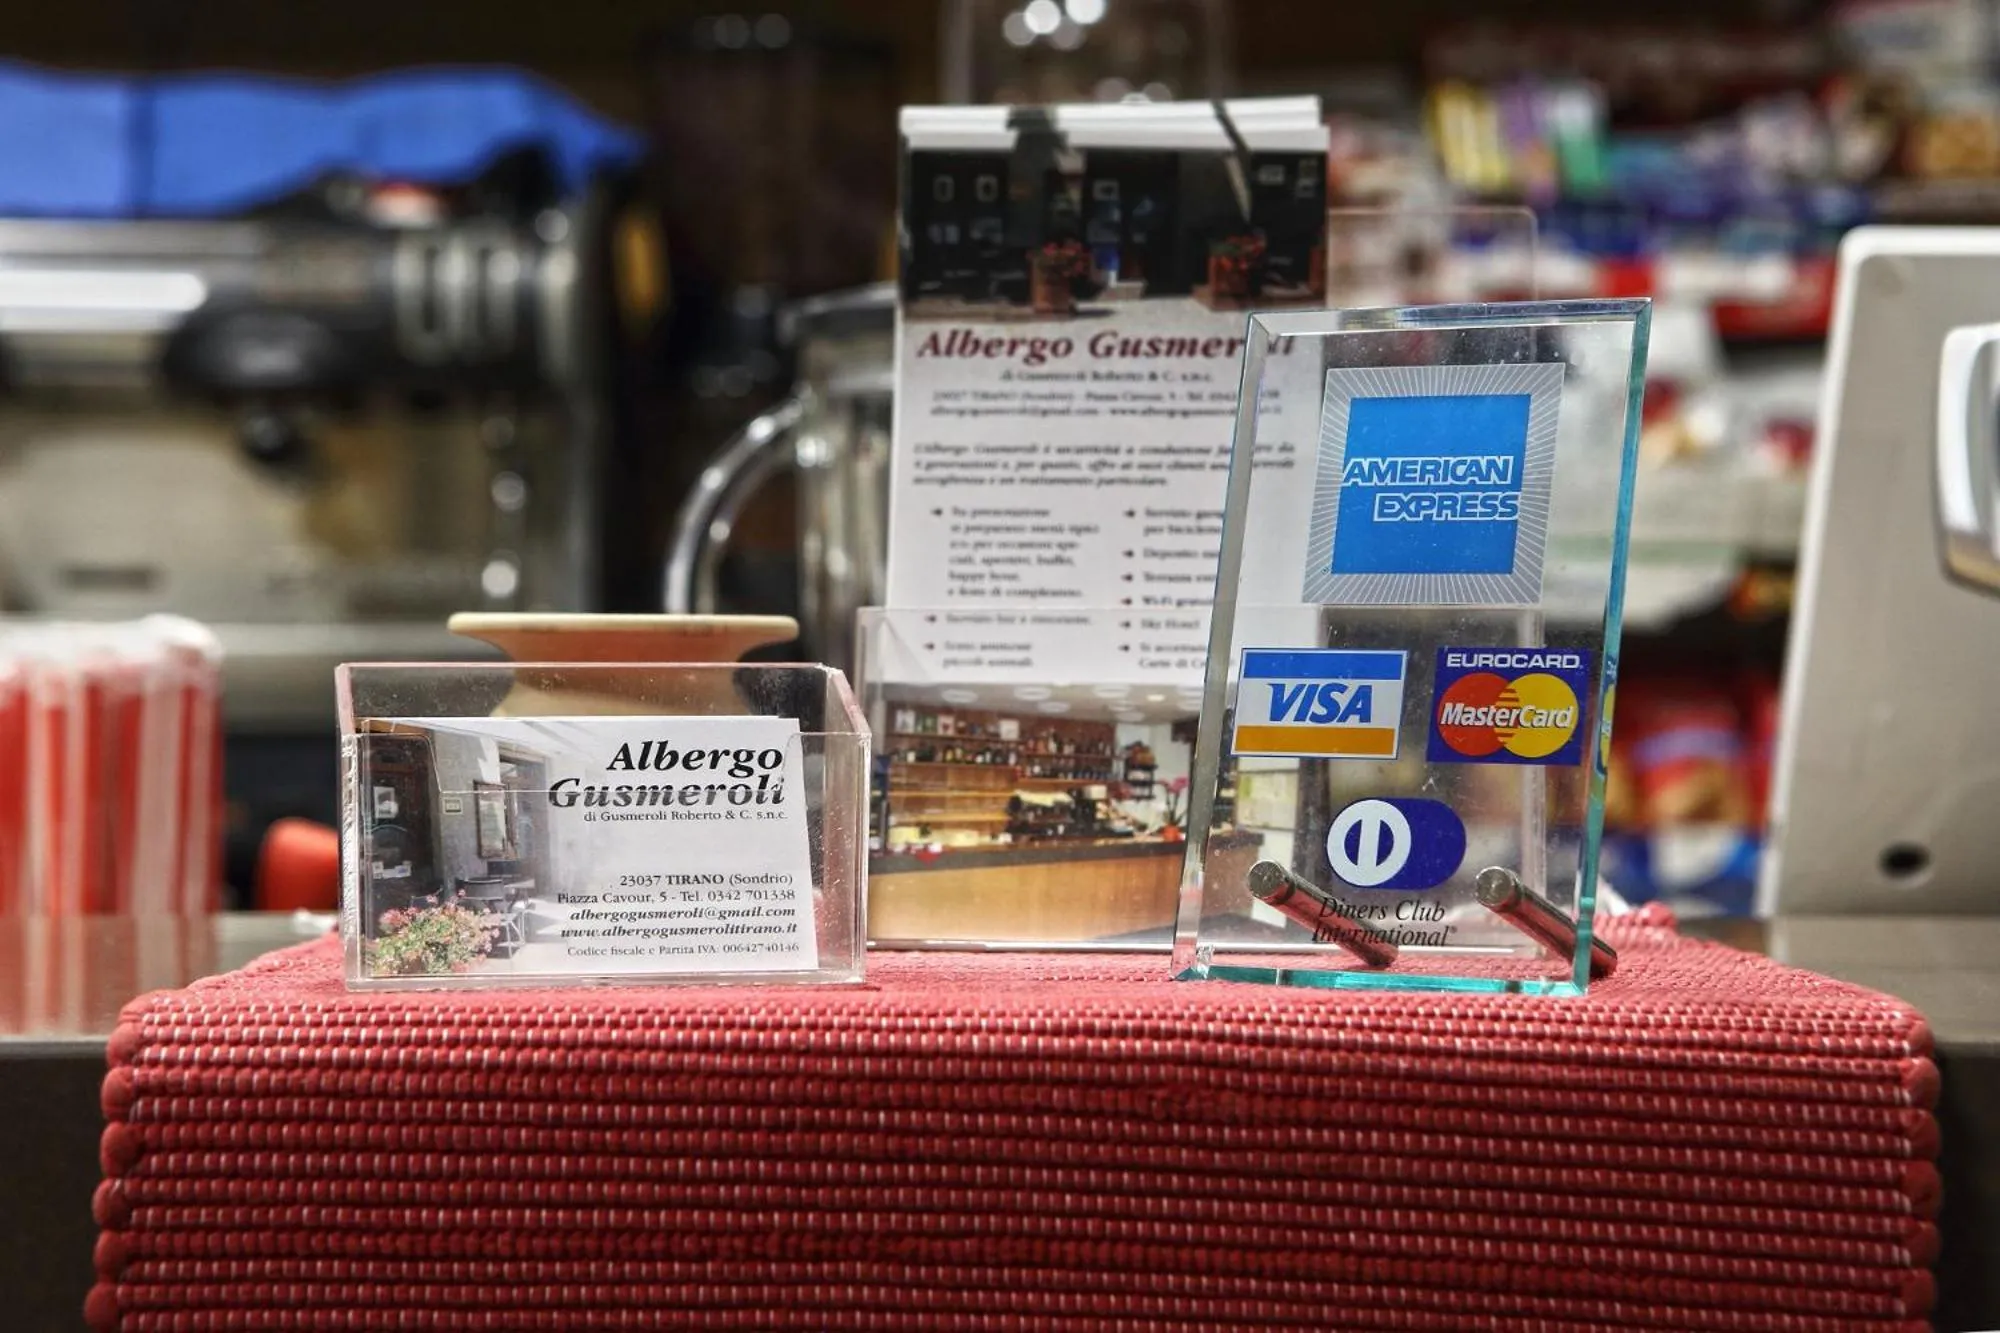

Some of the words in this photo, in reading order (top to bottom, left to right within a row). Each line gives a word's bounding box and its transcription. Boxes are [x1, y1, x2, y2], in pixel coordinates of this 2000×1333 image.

[916, 328, 1074, 366] Albergo
[1340, 455, 1514, 486] AMERICAN
[1373, 491, 1522, 522] EXPRESS
[1446, 653, 1580, 668] EUROCARD
[1267, 682, 1372, 724] VISA
[1441, 702, 1574, 728] MasterCard
[606, 740, 783, 778] Albergo
[549, 774, 785, 808] Gusmeroli
[584, 811, 597, 822] di
[601, 810, 667, 821] Gusmeroli
[671, 810, 721, 821] Roberto
[725, 811, 735, 820] &
[739, 810, 752, 819] C.
[757, 811, 787, 819] s.n.c.
[620, 875, 661, 887] 23037
[665, 873, 724, 885] TIRANO
[729, 872, 793, 886] (Sondrio)
[557, 892, 598, 904] Piazza
[602, 892, 655, 904] Cavour,
[659, 891, 667, 901] 5
[680, 890, 703, 902] Tel.
[707, 889, 741, 901] 0342
[745, 889, 796, 901] 701338
[569, 906, 796, 923] albergogusmeroli@gmail.com
[1319, 897, 1389, 920] Diners
[1395, 899, 1446, 922] Club
[560, 923, 798, 939] www.albergogusmerolitirano.it
[567, 946, 608, 956] Codice
[611, 945, 645, 956] fiscale
[648, 947, 655, 955] e
[659, 945, 694, 955] Partita
